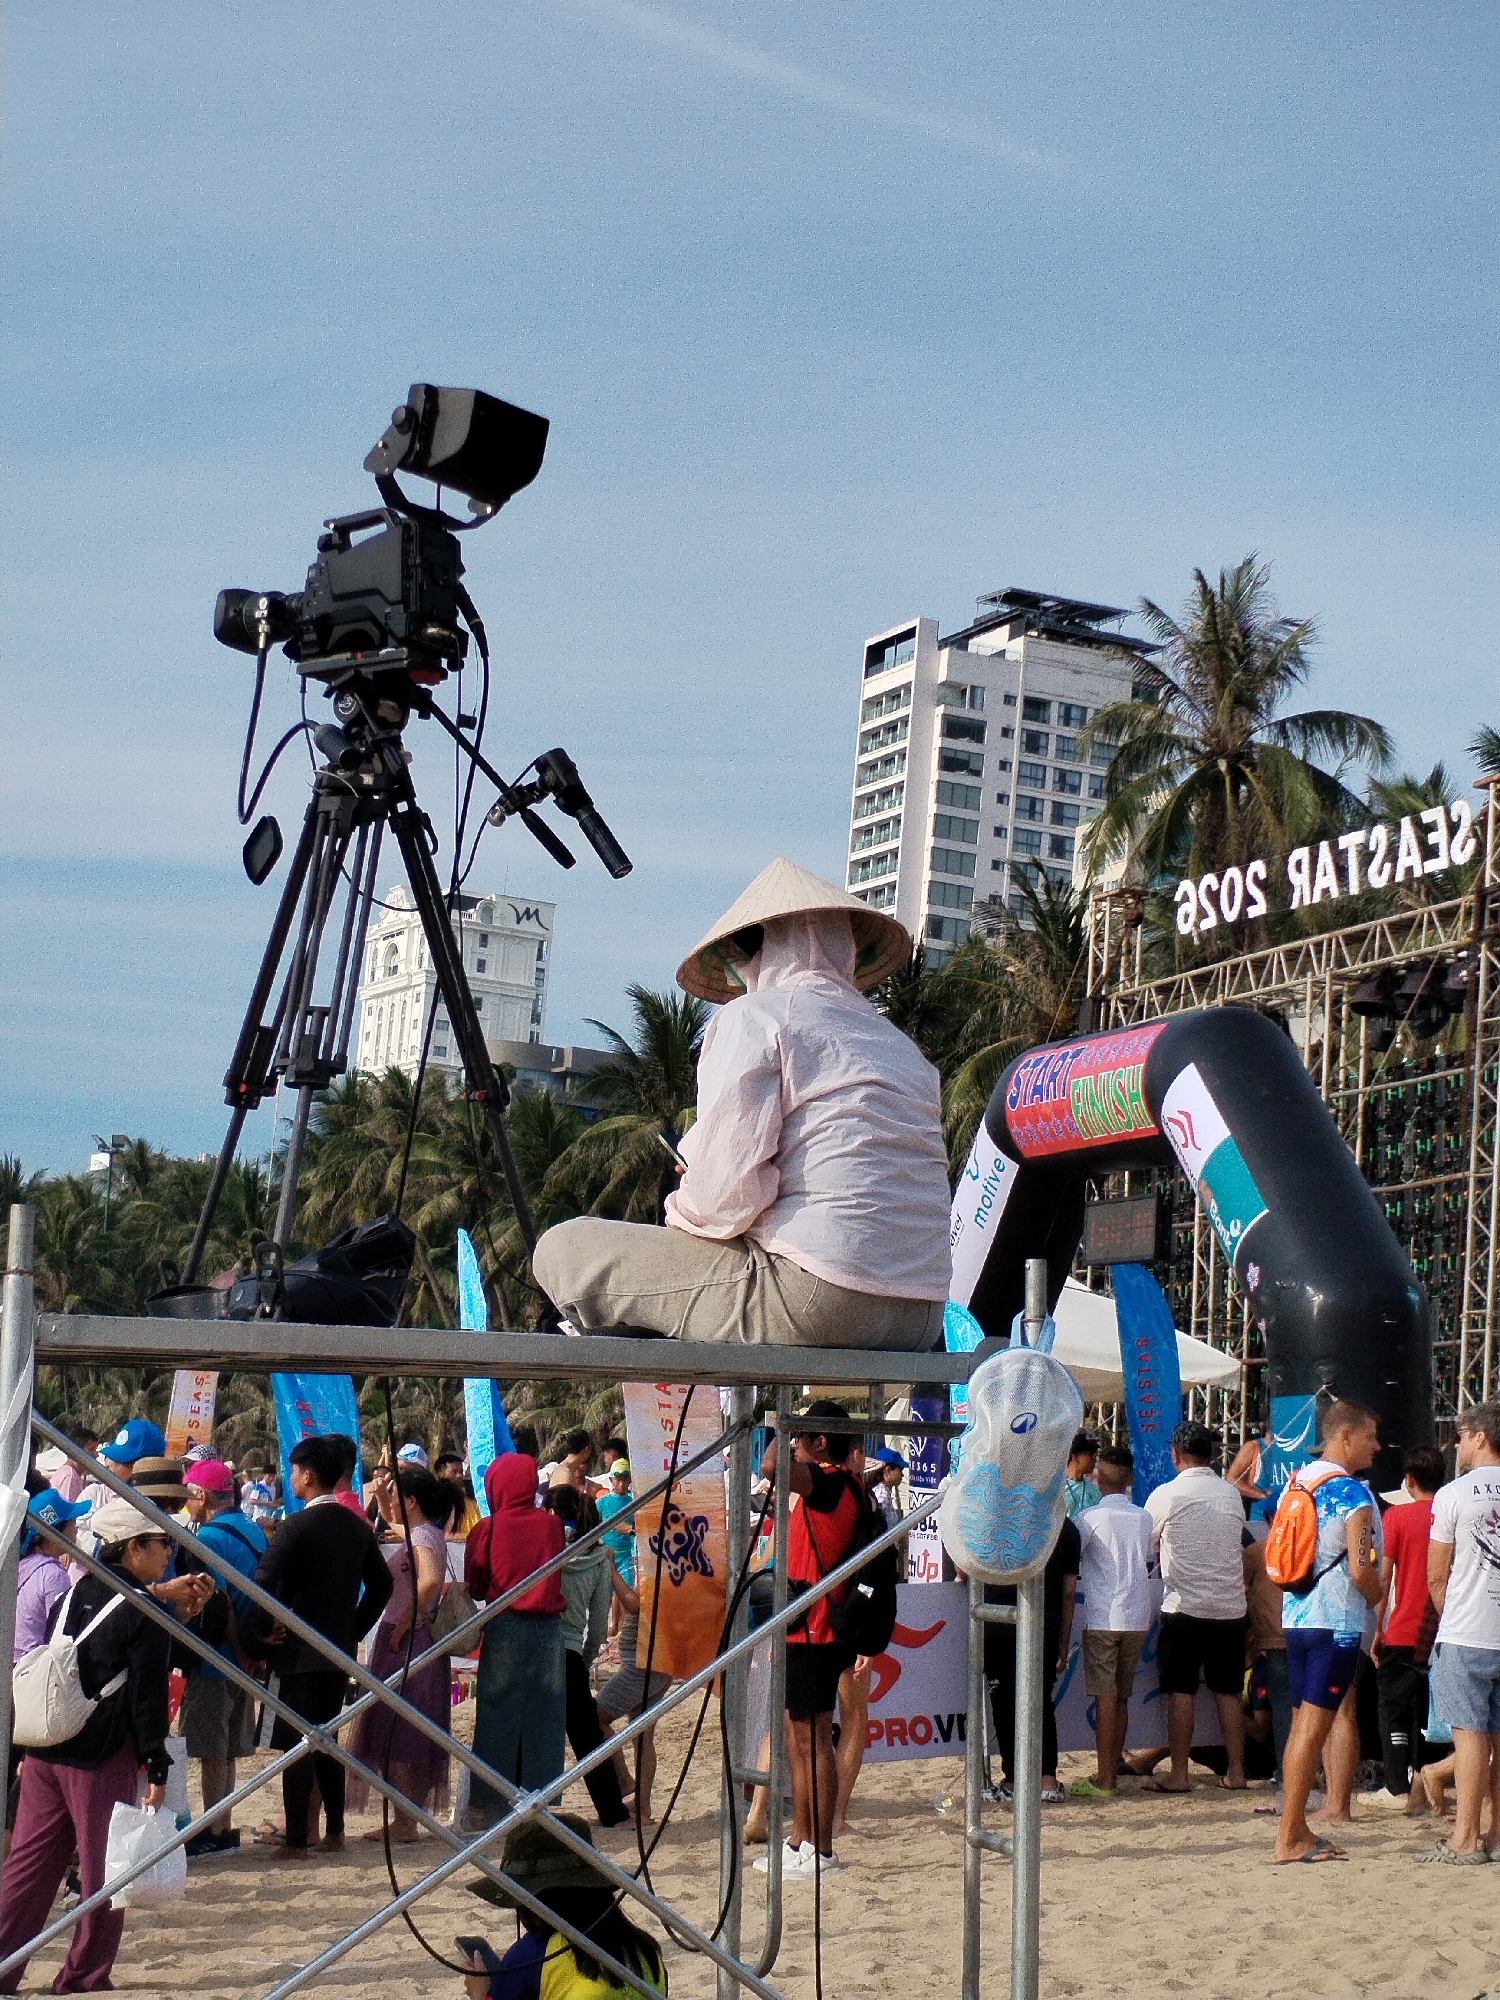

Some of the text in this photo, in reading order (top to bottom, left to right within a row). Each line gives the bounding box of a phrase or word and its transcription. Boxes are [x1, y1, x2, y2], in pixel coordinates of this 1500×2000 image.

[1007, 1046, 1087, 1111] START
[1071, 1064, 1156, 1140] FINISH
[974, 1158, 1006, 1229] motive
[188, 1376, 204, 1429] SEAS
[1136, 1337, 1155, 1432] SEASTAR
